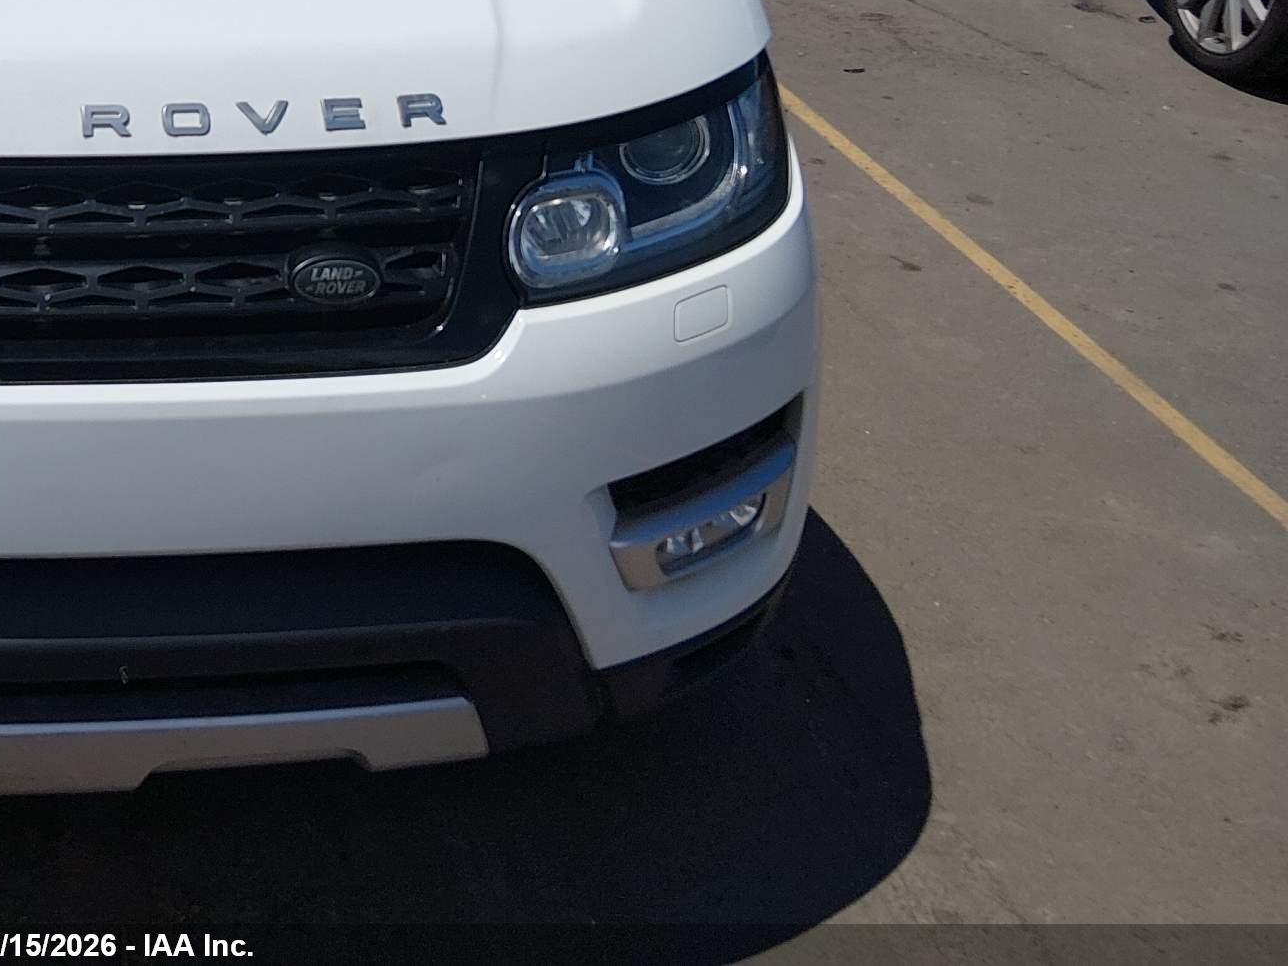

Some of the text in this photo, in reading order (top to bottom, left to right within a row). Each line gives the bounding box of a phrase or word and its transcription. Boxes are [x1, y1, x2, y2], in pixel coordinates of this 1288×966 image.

[80, 93, 447, 138] ROVER
[311, 267, 353, 282] LAND
[315, 281, 367, 295] ROVER
